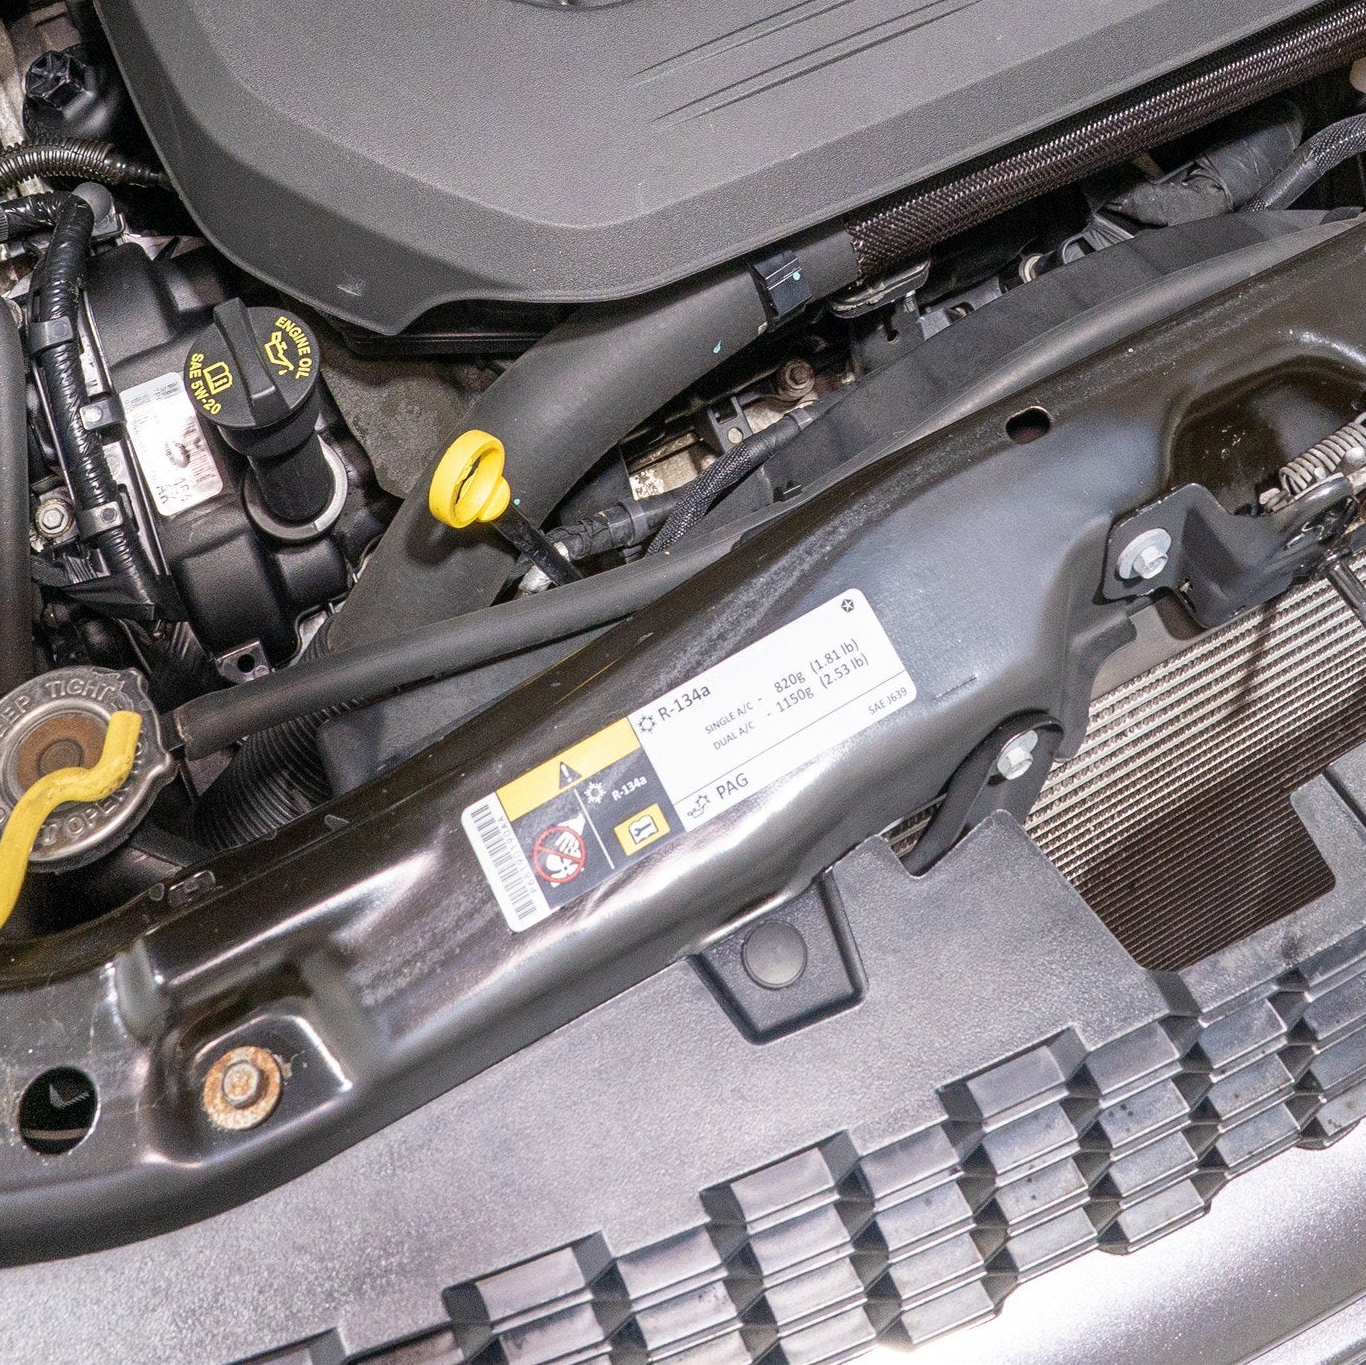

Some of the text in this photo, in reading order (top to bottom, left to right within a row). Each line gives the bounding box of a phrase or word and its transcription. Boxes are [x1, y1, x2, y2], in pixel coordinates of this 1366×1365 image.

[275, 316, 313, 379] ENGINE OIL
[189, 353, 205, 379] SAE
[190, 381, 222, 415] 5W-20
[45, 678, 116, 701] TIGHT
[704, 710, 736, 735] SINGLE
[734, 699, 754, 717] A/C
[773, 668, 806, 696] 820g
[808, 647, 841, 675] (1.81
[839, 635, 860, 657] lb)
[712, 730, 738, 751] DUAL
[736, 719, 756, 737] A/C
[775, 684, 815, 716] 1150g
[817, 661, 852, 690] (2.53
[848, 650, 870, 672] lb)
[867, 685, 909, 715] SAE J639
[657, 681, 712, 722] R-134a
[610, 772, 648, 802] R-134a
[715, 770, 750, 801] PAG
